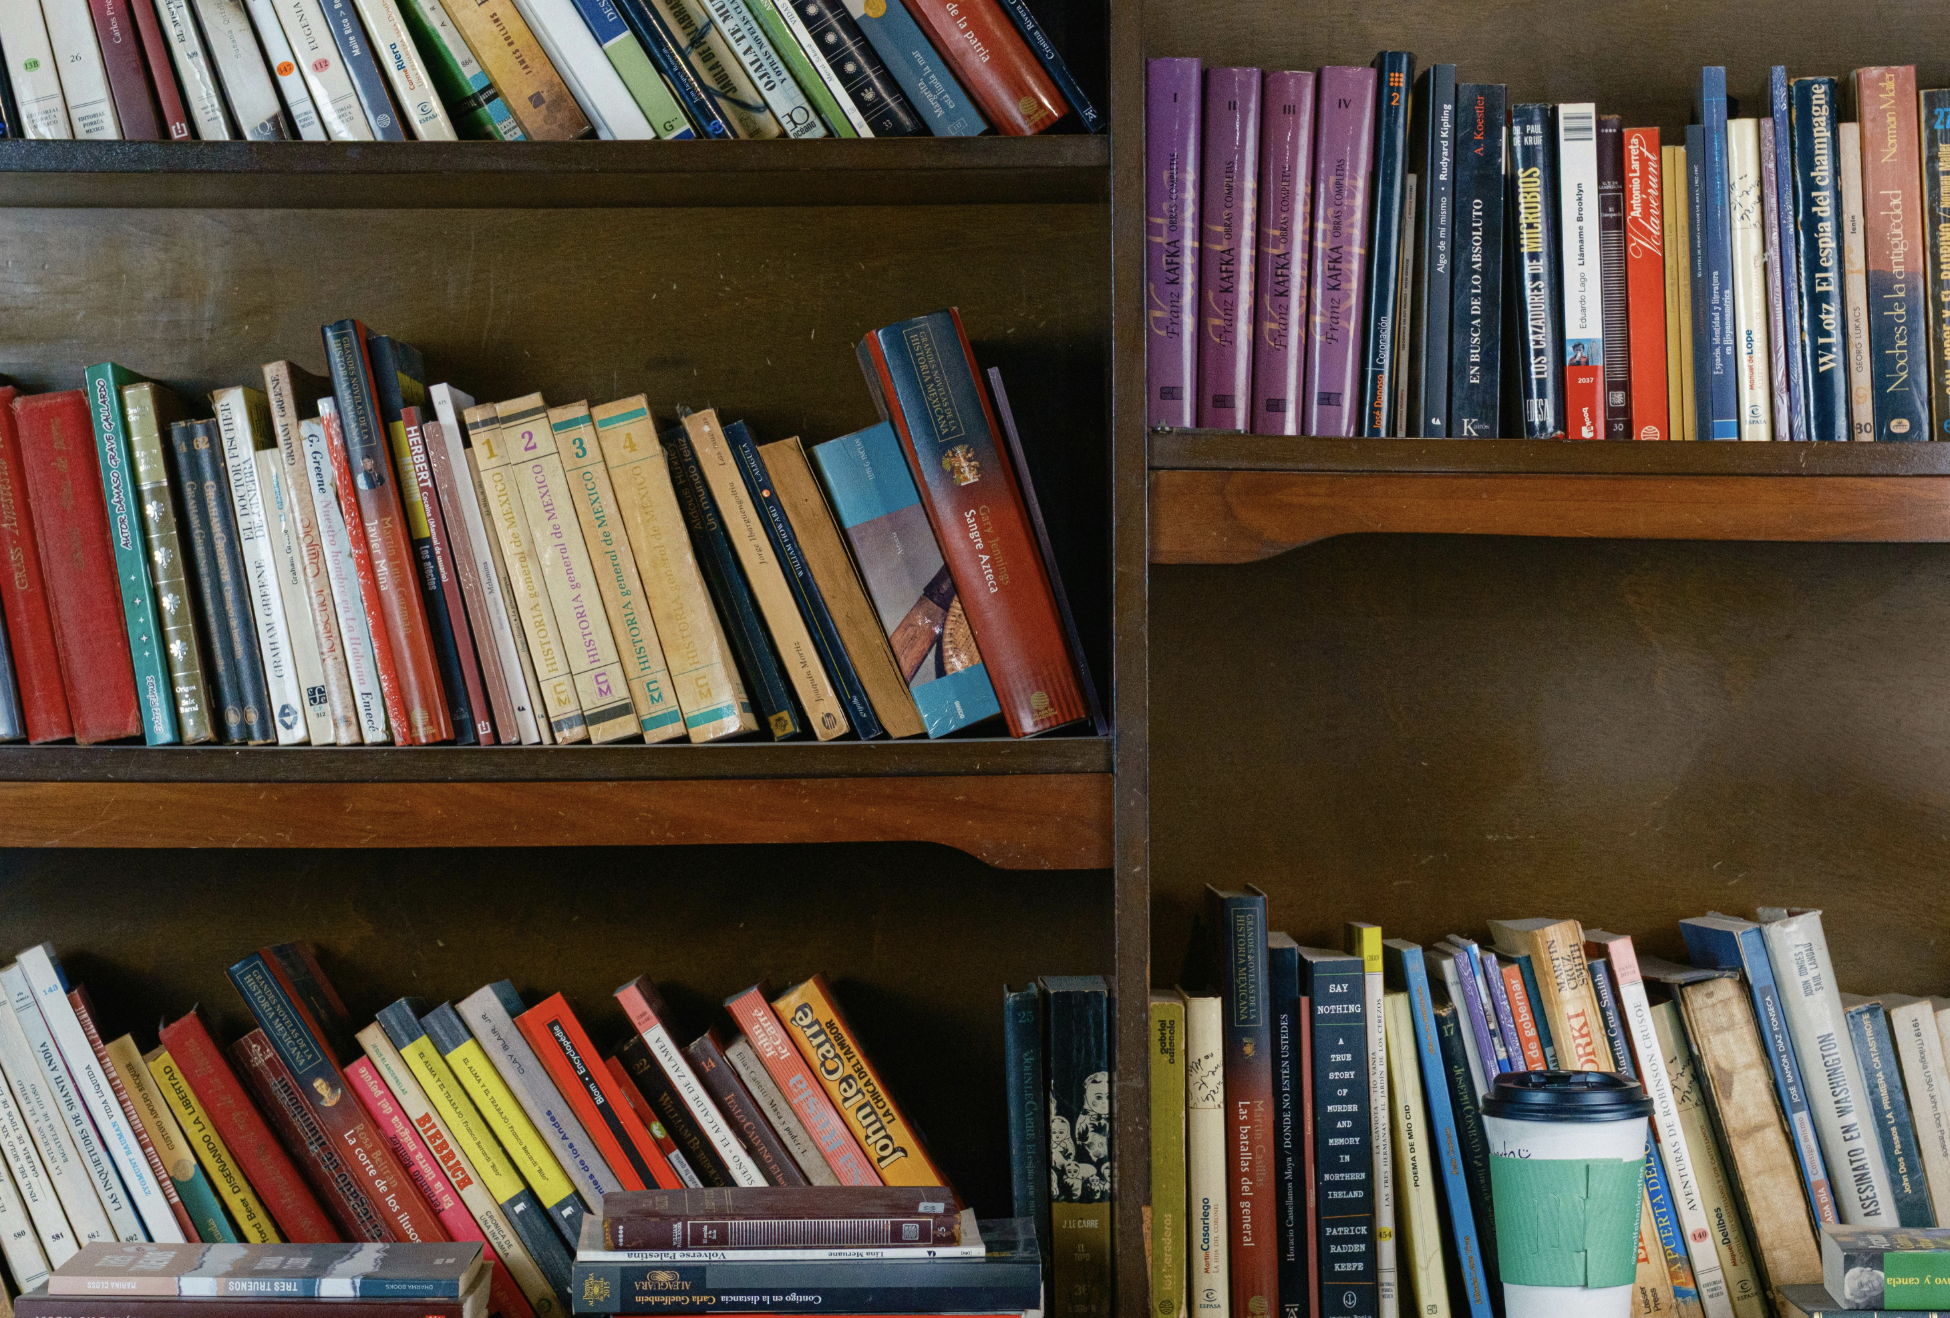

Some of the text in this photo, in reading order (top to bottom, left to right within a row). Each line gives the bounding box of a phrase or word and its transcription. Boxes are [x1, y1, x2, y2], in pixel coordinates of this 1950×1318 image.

[110, 17, 122, 44] Carlos
[228, 29, 242, 59] Susana
[293, 2, 319, 51] EUGENIA
[342, 18, 361, 57] Maite Rico
[490, 12, 532, 75] JAMES ROLLINS
[727, 23, 747, 47] TE
[946, 2, 991, 64] de la patria
[1016, 6, 1055, 60] Cristina Rivera
[24, 61, 39, 70] 13B
[70, 54, 82, 63] 26
[314, 60, 328, 71] 112
[707, 64, 738, 95] JAULA
[918, 78, 946, 118] Margarita,
[78, 111, 105, 122] EDITORIAL
[1337, 98, 1352, 110] IV
[1391, 92, 1400, 106] 2
[882, 120, 893, 130] 33
[1440, 104, 1452, 138] Kipling
[1474, 95, 1485, 156] A. Koestler
[1512, 125, 1543, 135] DR. PAUL
[1440, 140, 1451, 181] Rudyard
[1629, 138, 1641, 217] Antonio Larreta
[1438, 239, 1445, 250] de
[1439, 227, 1446, 239] mí
[1577, 224, 1586, 266] Llámame
[1879, 73, 1909, 393] Noches de la antigüedad Norman Mailer
[1437, 252, 1447, 273] Algo
[1517, 166, 1547, 379] LOS CAZADORES DE MICROBIOS
[1470, 199, 1483, 384] EN BUSCA DE LO ABSOLUTO
[1578, 272, 1588, 329] Eduardo Lago
[1376, 316, 1388, 365] Coronación
[333, 339, 361, 443] HISTORIA MEXICANA
[909, 334, 949, 436] HISTORIA MEXICANA
[1577, 377, 1594, 385] 2037
[271, 374, 296, 467] GRAHAM GREENE
[1373, 374, 1384, 430] José Donoso
[521, 430, 537, 452] 2
[622, 432, 638, 453] 4
[1613, 423, 1624, 431] 30
[307, 433, 327, 494] G. Greene
[572, 437, 587, 459] 3
[365, 520, 389, 591] Javier Mina
[531, 464, 600, 665] HISTORIA general de MEXICO
[964, 509, 998, 594] Sangre Azteca
[978, 505, 1010, 586] Gary Jennings
[491, 472, 559, 673] HISTORIA general de MEXICO
[582, 471, 652, 672] HISTORIA general de MEXICO
[254, 559, 285, 679] GRAHAM GREENE
[360, 691, 379, 733] Emecé
[1236, 914, 1248, 1020] HISTORIA MEXICANA
[1329, 983, 1349, 993] SAY
[243, 974, 305, 1068] HISTORIA MEXICANA
[252, 969, 313, 1061] GRANDES NOVELAS DE LA
[1317, 1004, 1361, 1014] NOTHING
[752, 1021, 780, 1058] John
[1330, 1053, 1352, 1062] TRUE
[553, 1024, 605, 1106] Blom Encyclopédie
[700, 1057, 717, 1074] 14
[824, 1018, 897, 1124] LA CHICA DEL TAMBOR
[1329, 1071, 1355, 1079] STORY
[655, 1037, 756, 1186] SUEÑO EL ALCALDE DE ZALAMEA
[1327, 1104, 1358, 1112] MURDER
[1336, 1120, 1352, 1128] AND
[1633, 1001, 1697, 1211] AVENTURAS DE ROBINSON CRUSOE
[1817, 1032, 1882, 1218] ASESINATO EN WASHINGTON
[163, 1064, 241, 1195] DISEÑANDO LA LIBERTAD
[545, 1109, 590, 1173] de los Andes
[1328, 1137, 1360, 1145] MEMORY
[415, 1111, 474, 1192] BIEBRICH
[1339, 1154, 1350, 1163] IN
[1238, 1101, 1255, 1247] Las batallas del general
[1324, 1172, 1366, 1181] NORTHERN
[240, 1196, 257, 1221] Beer
[1327, 1190, 1364, 1199] IRELAND
[1325, 1226, 1368, 1236] PATRICK
[1330, 1244, 1366, 1253] RADDEN
[627, 1251, 727, 1260] Volverse Palestina
[1334, 1263, 1364, 1271] KEEFE
[228, 1281, 298, 1293] TRES TRUENOS
[634, 1280, 691, 1290] ALFAGUARA
